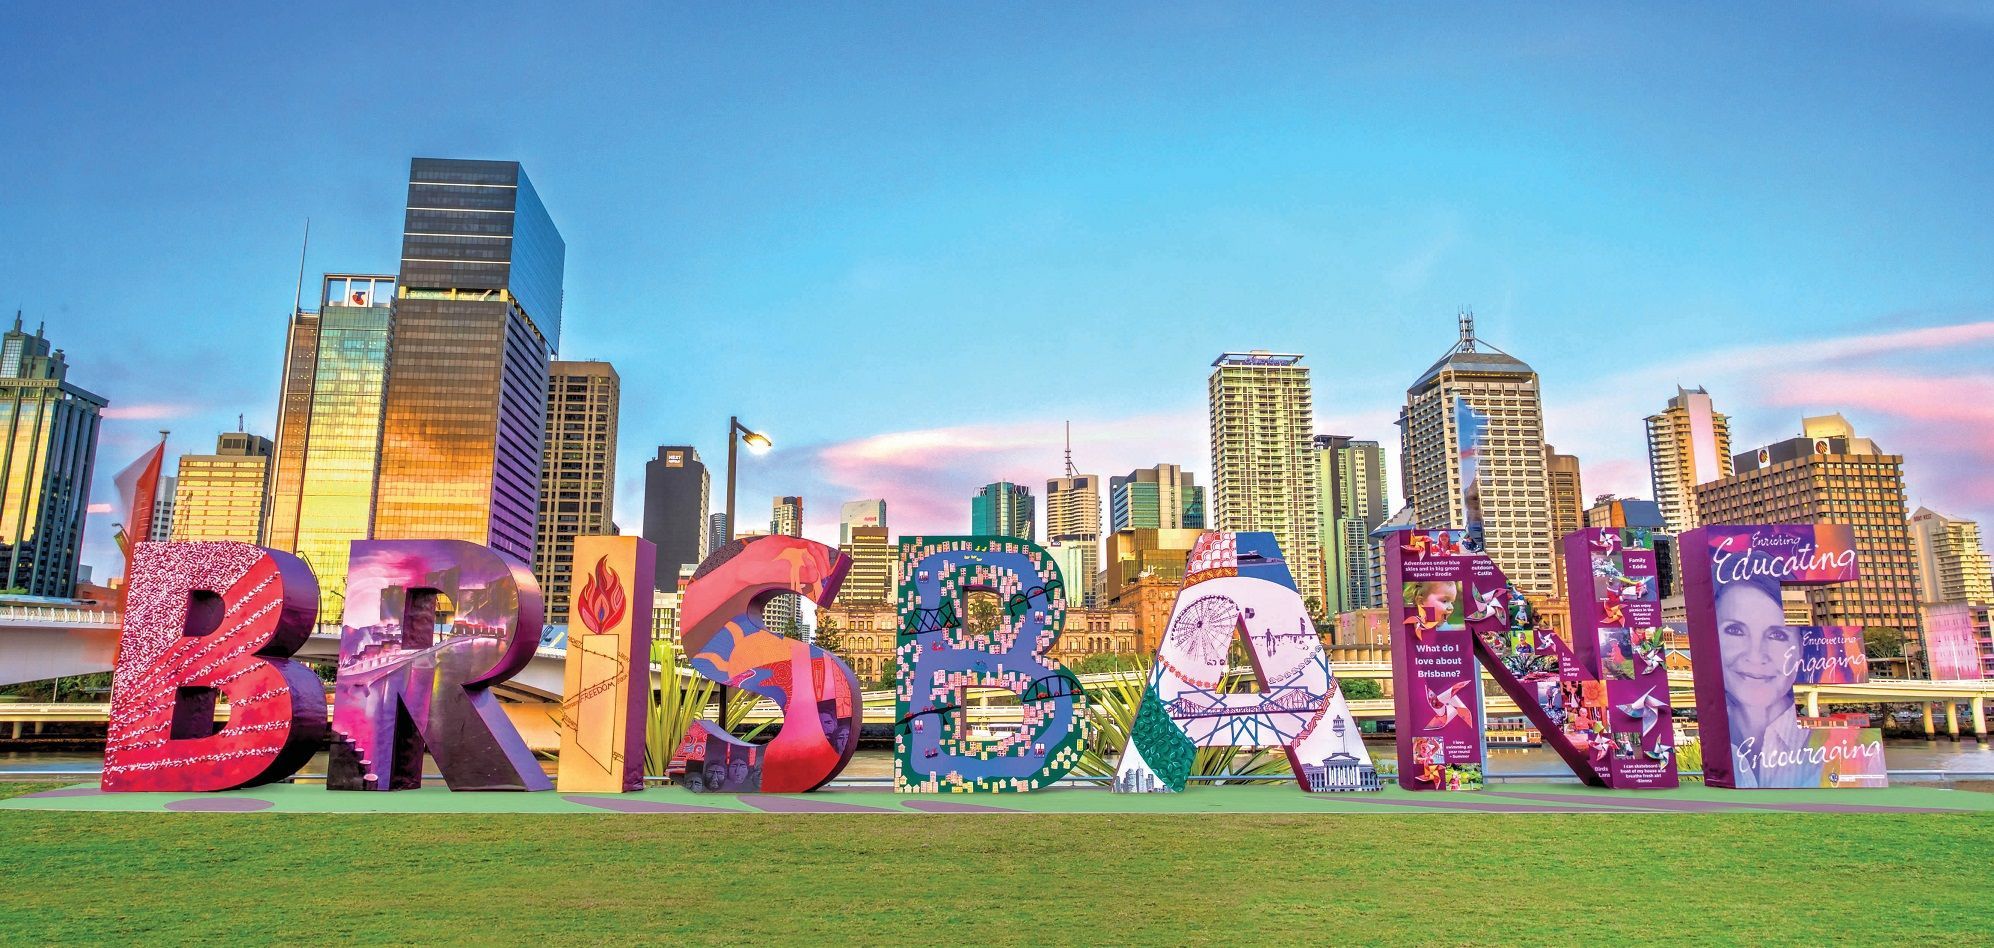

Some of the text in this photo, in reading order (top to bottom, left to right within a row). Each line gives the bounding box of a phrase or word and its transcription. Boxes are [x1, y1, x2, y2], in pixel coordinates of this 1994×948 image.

[1752, 531, 1801, 549] Enriching
[1713, 537, 1855, 584] Educating
[1416, 644, 1440, 652] What
[1442, 644, 1454, 652] do
[1415, 657, 1462, 665] love about
[1783, 645, 1866, 681] Engaging
[1417, 670, 1461, 678] Brisbane?
[579, 682, 615, 703] FREEDOM
[1736, 736, 1881, 773] Encouraging
